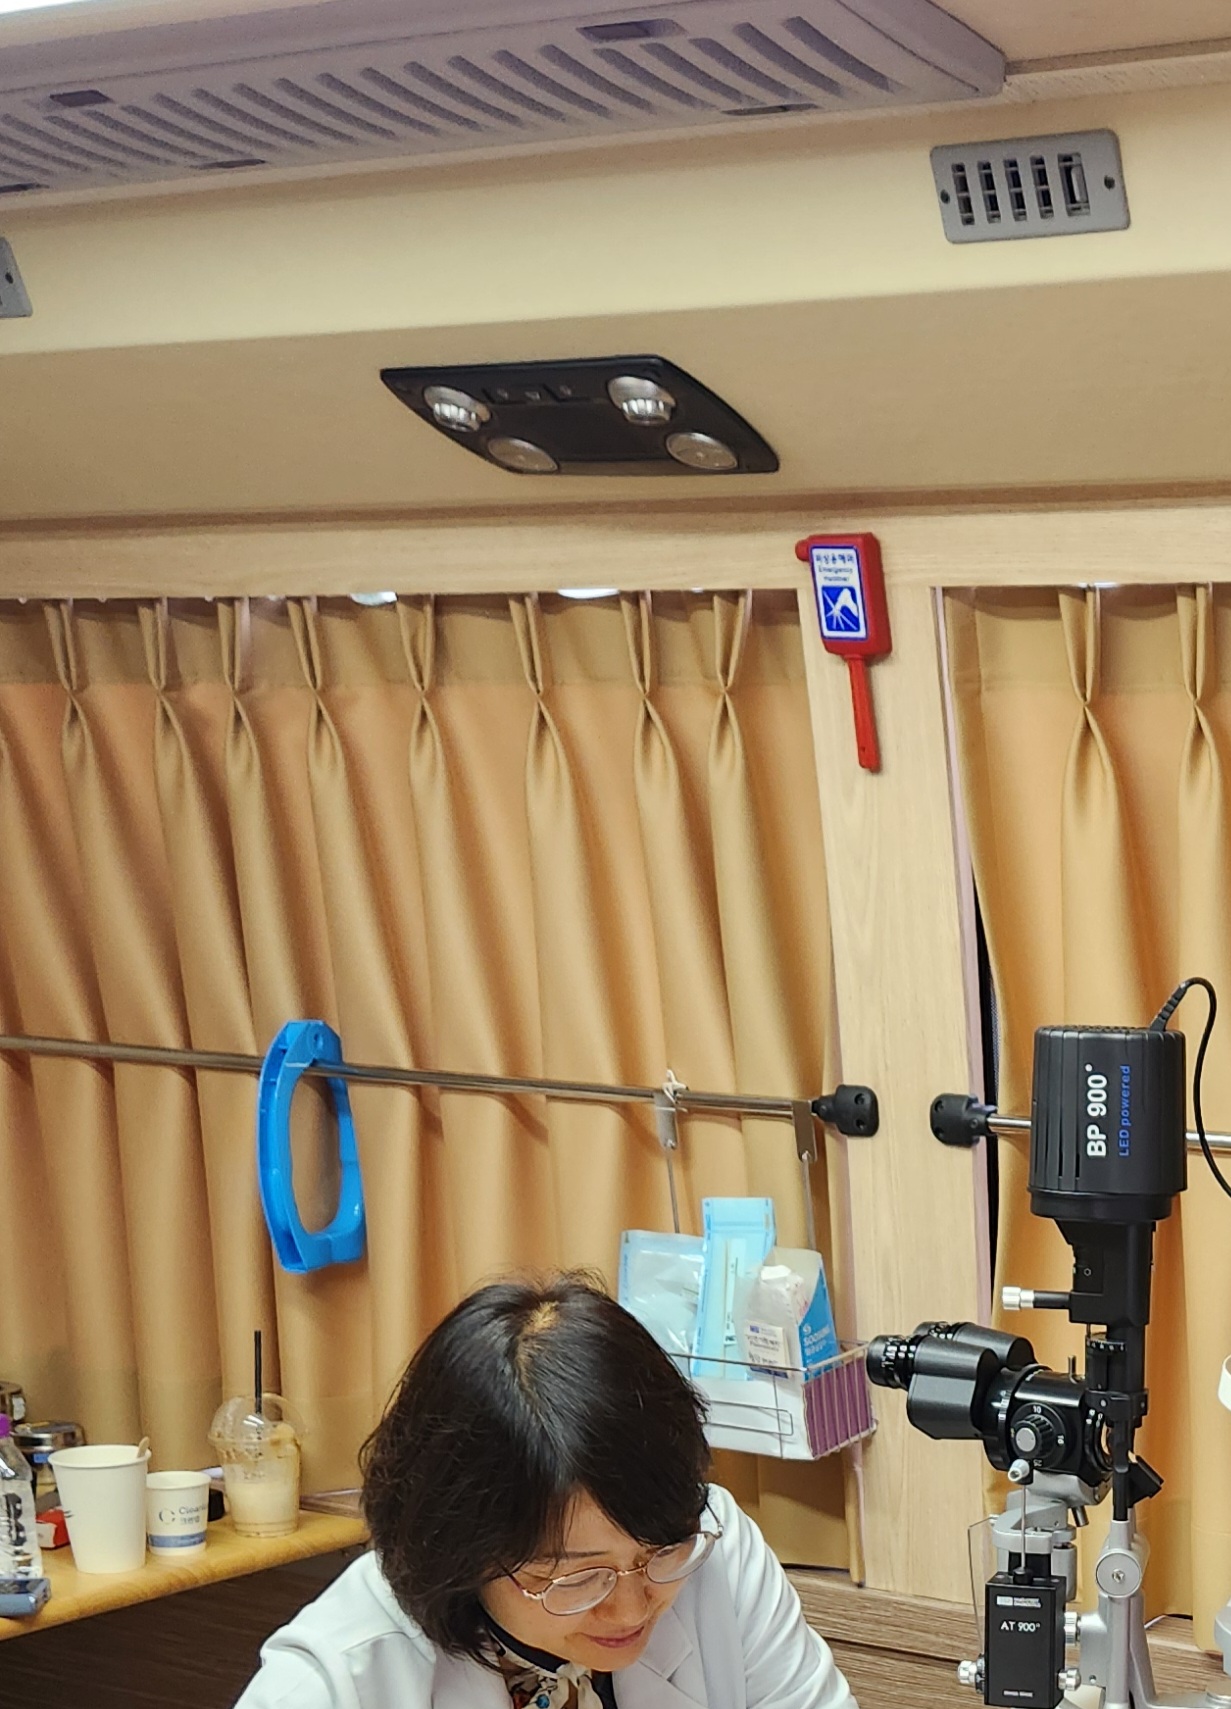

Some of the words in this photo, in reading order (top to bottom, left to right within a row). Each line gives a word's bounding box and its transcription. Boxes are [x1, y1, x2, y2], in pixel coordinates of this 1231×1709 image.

[1119, 1064, 1131, 1127] powered
[1086, 1124, 1107, 1158] BP
[1118, 1129, 1130, 1157] LED
[1032, 1405, 1042, 1414] 10
[1000, 1620, 1016, 1631] AT
